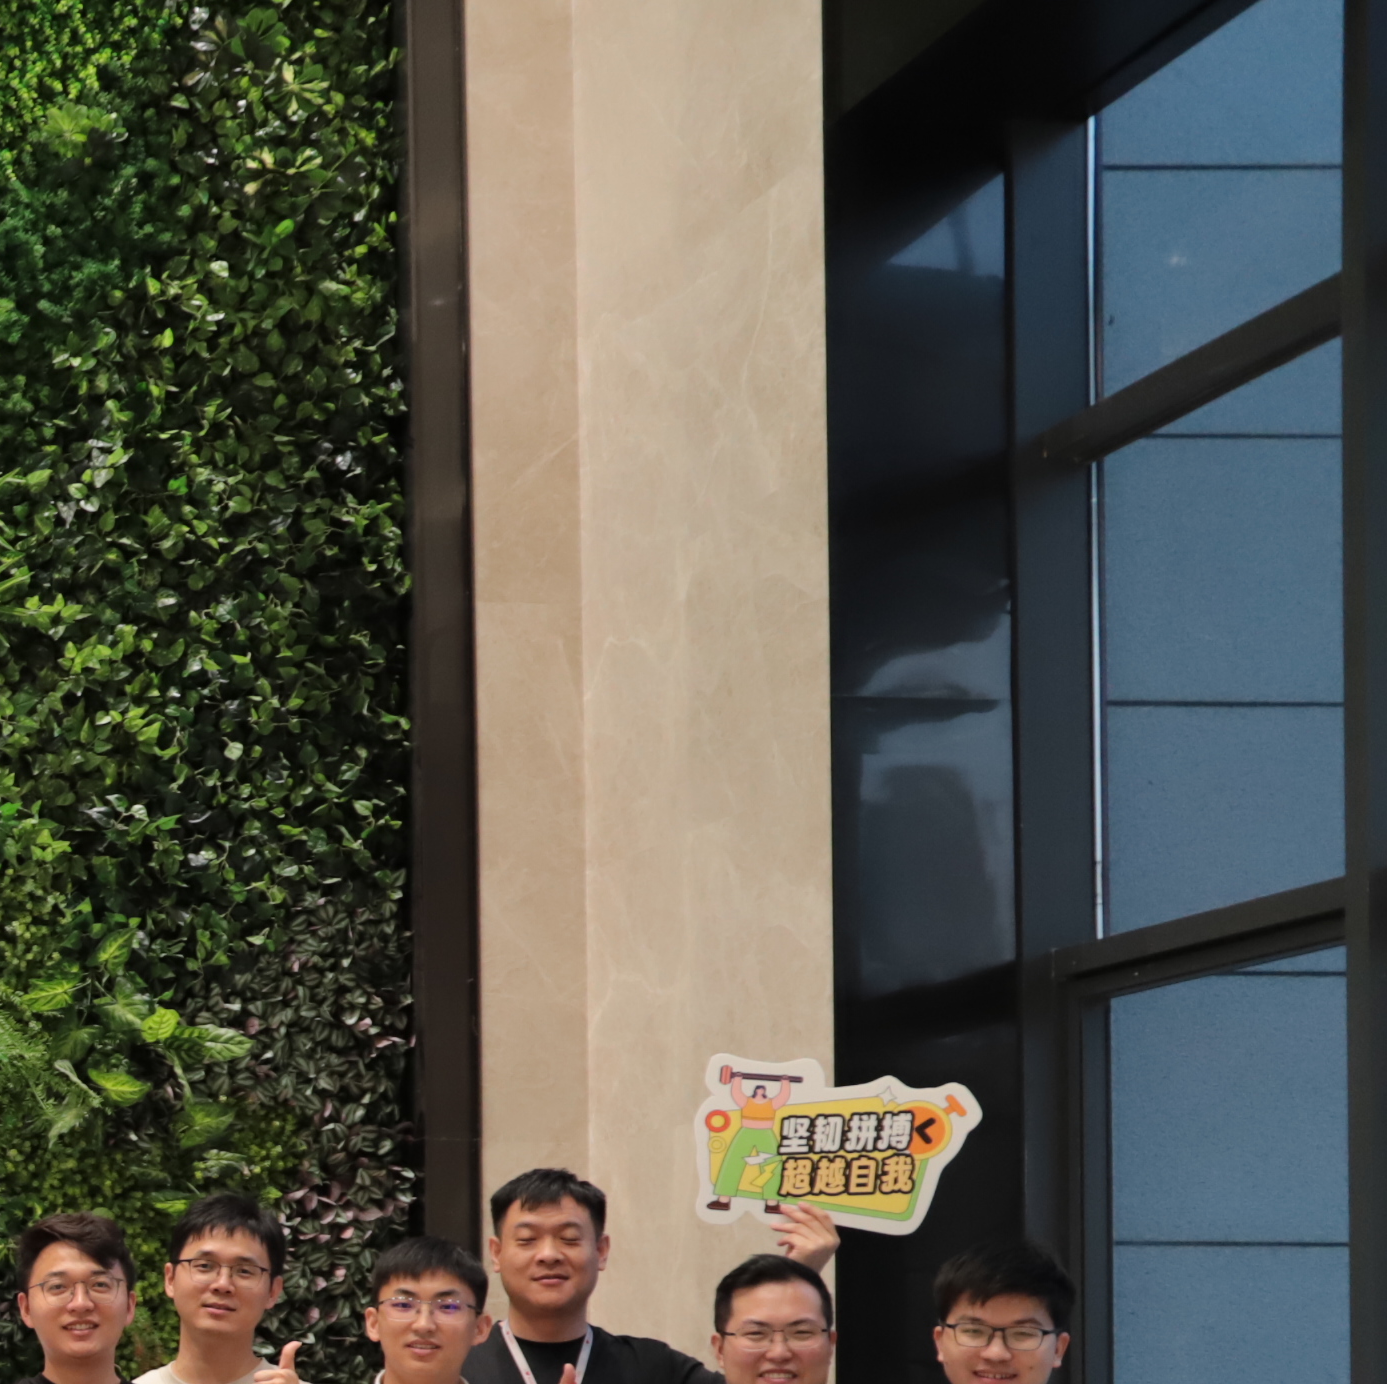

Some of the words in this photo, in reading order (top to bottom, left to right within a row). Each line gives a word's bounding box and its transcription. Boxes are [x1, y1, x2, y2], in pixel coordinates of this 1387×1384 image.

[778, 1110, 914, 1154] 坚韧拼搏
[778, 1154, 915, 1197] 超越自我
